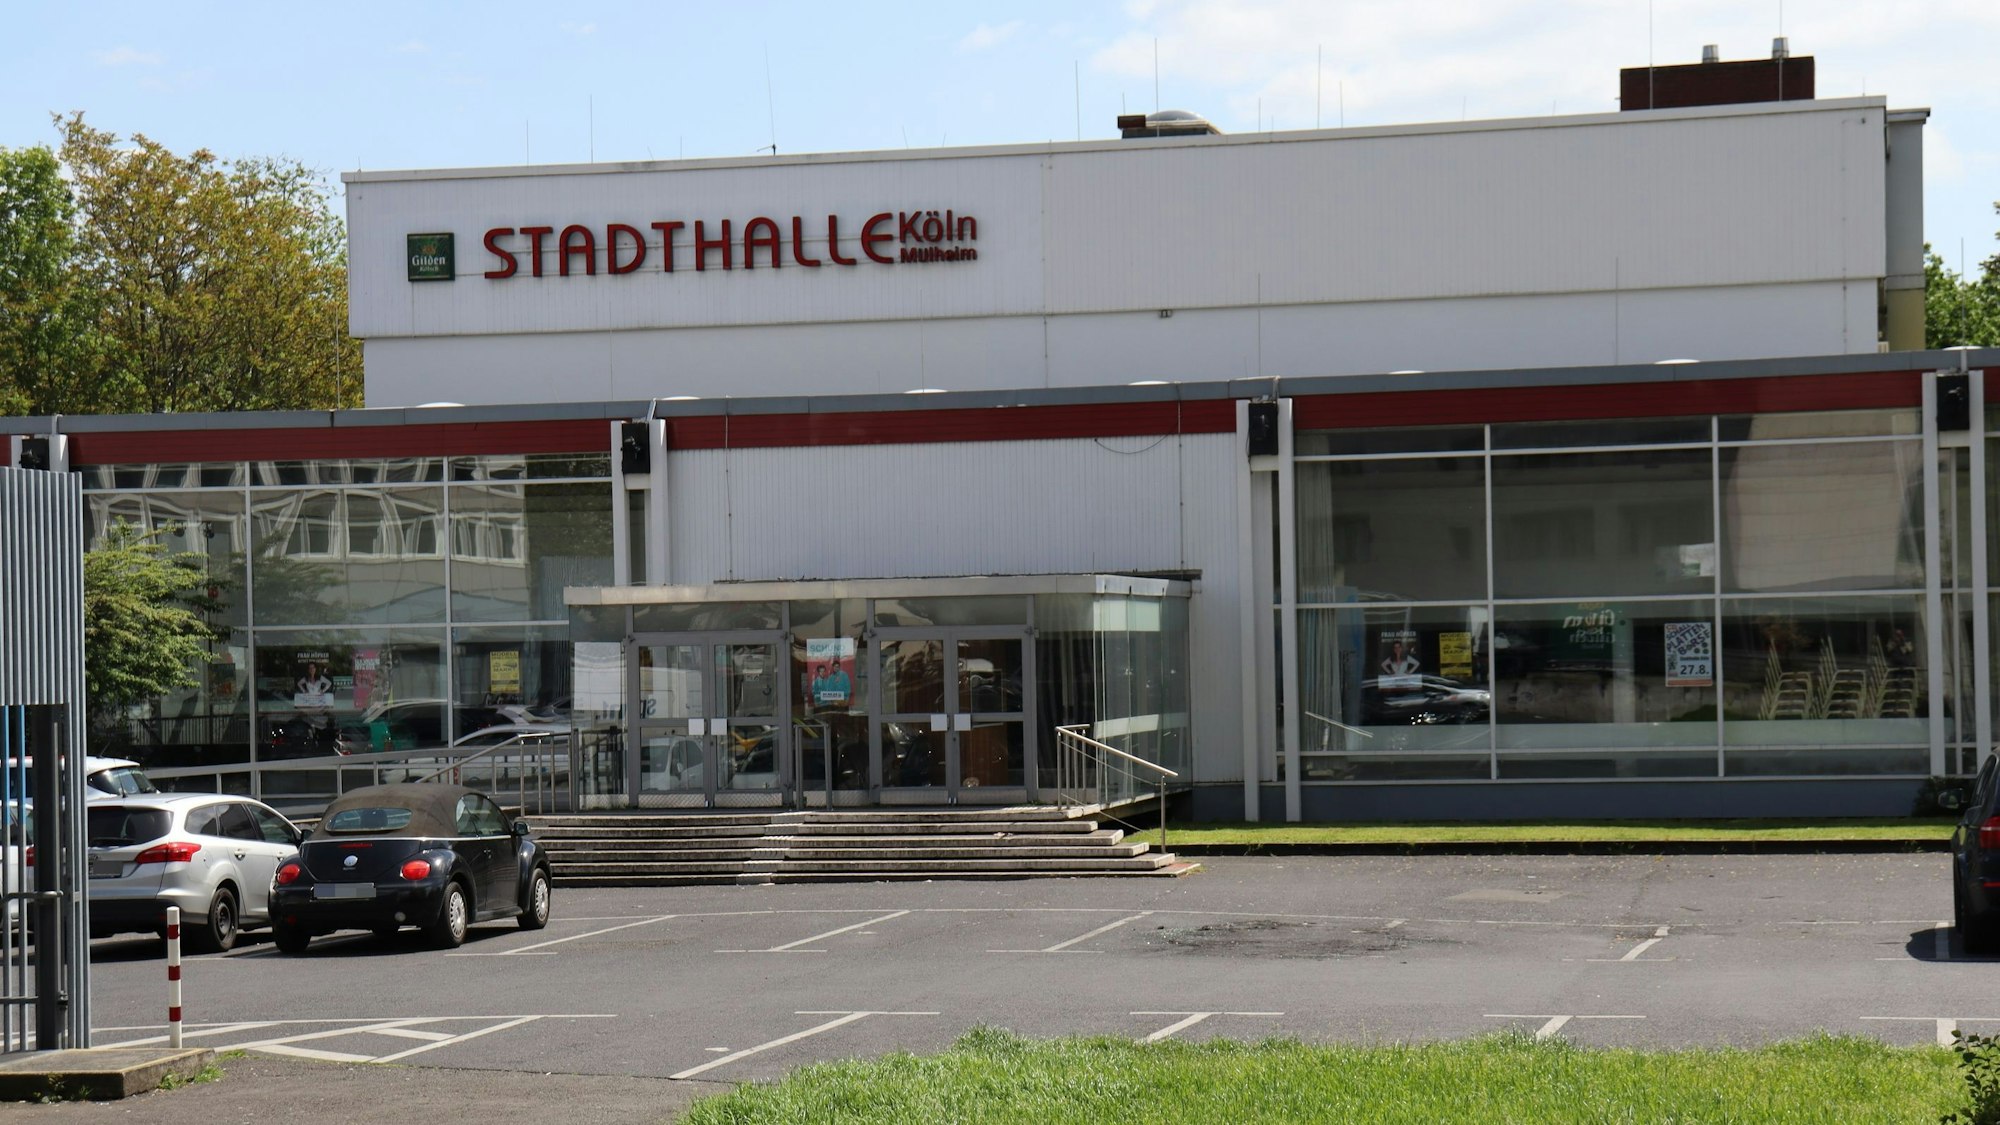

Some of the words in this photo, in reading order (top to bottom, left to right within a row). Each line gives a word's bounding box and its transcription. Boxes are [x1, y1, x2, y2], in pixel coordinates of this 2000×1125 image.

[484, 213, 894, 279] STADTHALLE
[899, 209, 978, 243] Köln
[412, 254, 446, 266] Gilden
[1666, 623, 1706, 653] PLATTEN
[1680, 664, 1710, 675] 27.8.
